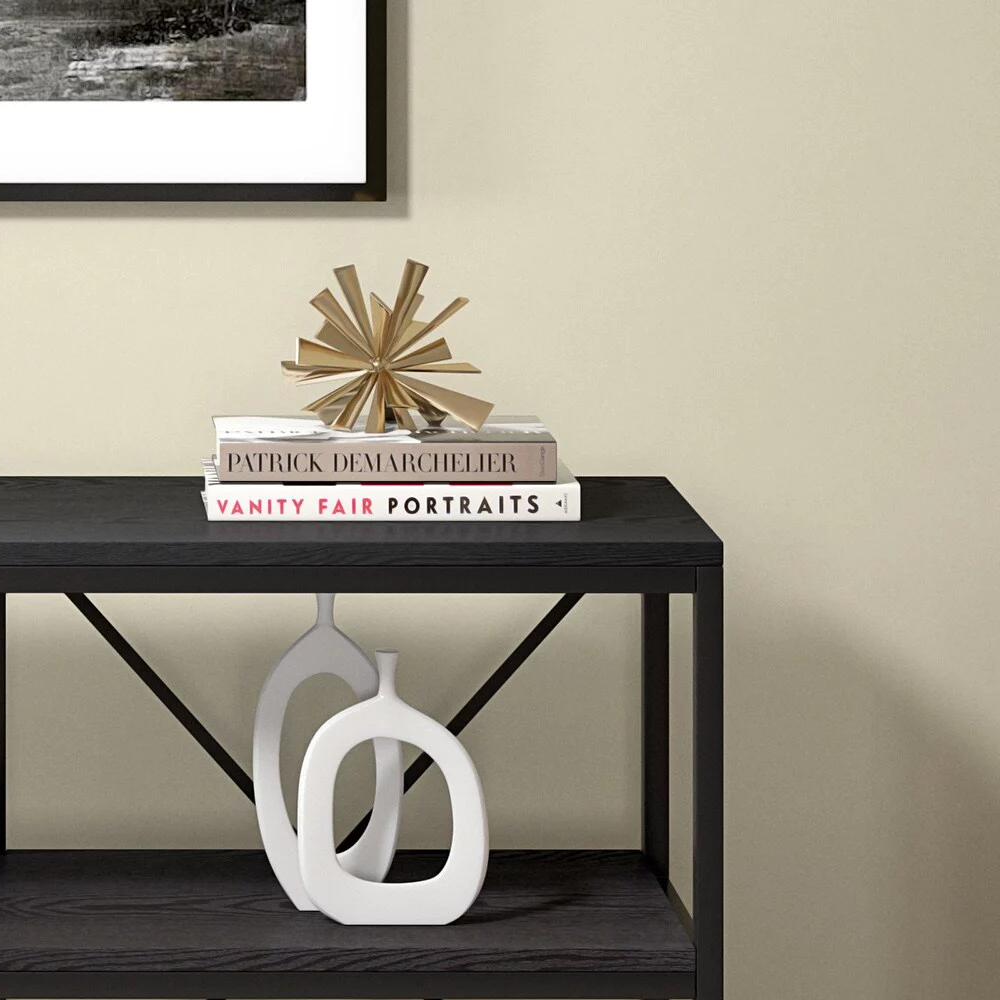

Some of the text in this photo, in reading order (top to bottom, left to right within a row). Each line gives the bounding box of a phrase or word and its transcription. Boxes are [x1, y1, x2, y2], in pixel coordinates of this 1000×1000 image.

[227, 452, 323, 473] PATRICK
[333, 452, 517, 473] DEMARCHELIER
[216, 494, 540, 516] VANITY FAIR PORTRAITS
